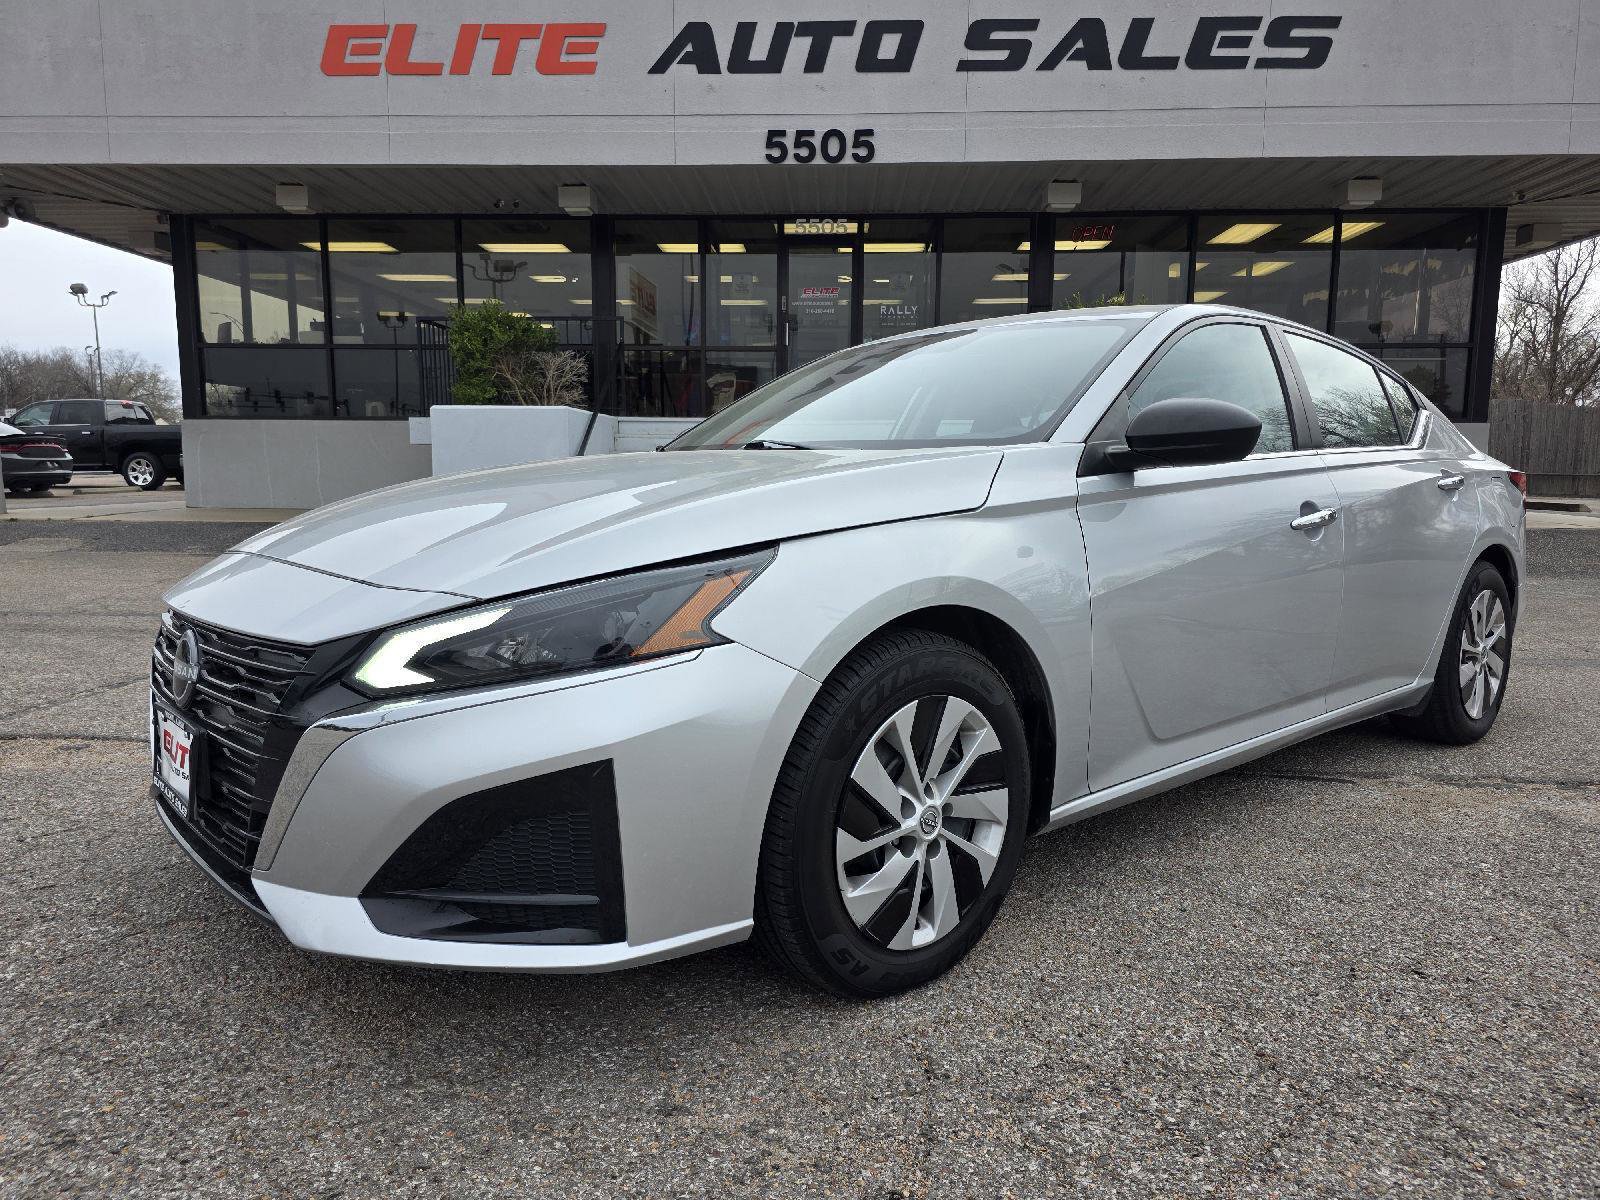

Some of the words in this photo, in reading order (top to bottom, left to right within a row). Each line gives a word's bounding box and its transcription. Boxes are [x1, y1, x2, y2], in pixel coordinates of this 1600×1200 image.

[320, 23, 607, 76] ELITE
[647, 19, 925, 75] AUTO
[956, 15, 1343, 72] SALES
[764, 128, 876, 164] 5505
[794, 218, 849, 235] 5505
[1071, 225, 1116, 242] OPEN
[802, 287, 841, 296] ELITE
[880, 305, 918, 315] RALLY
[162, 728, 191, 770] ELIT
